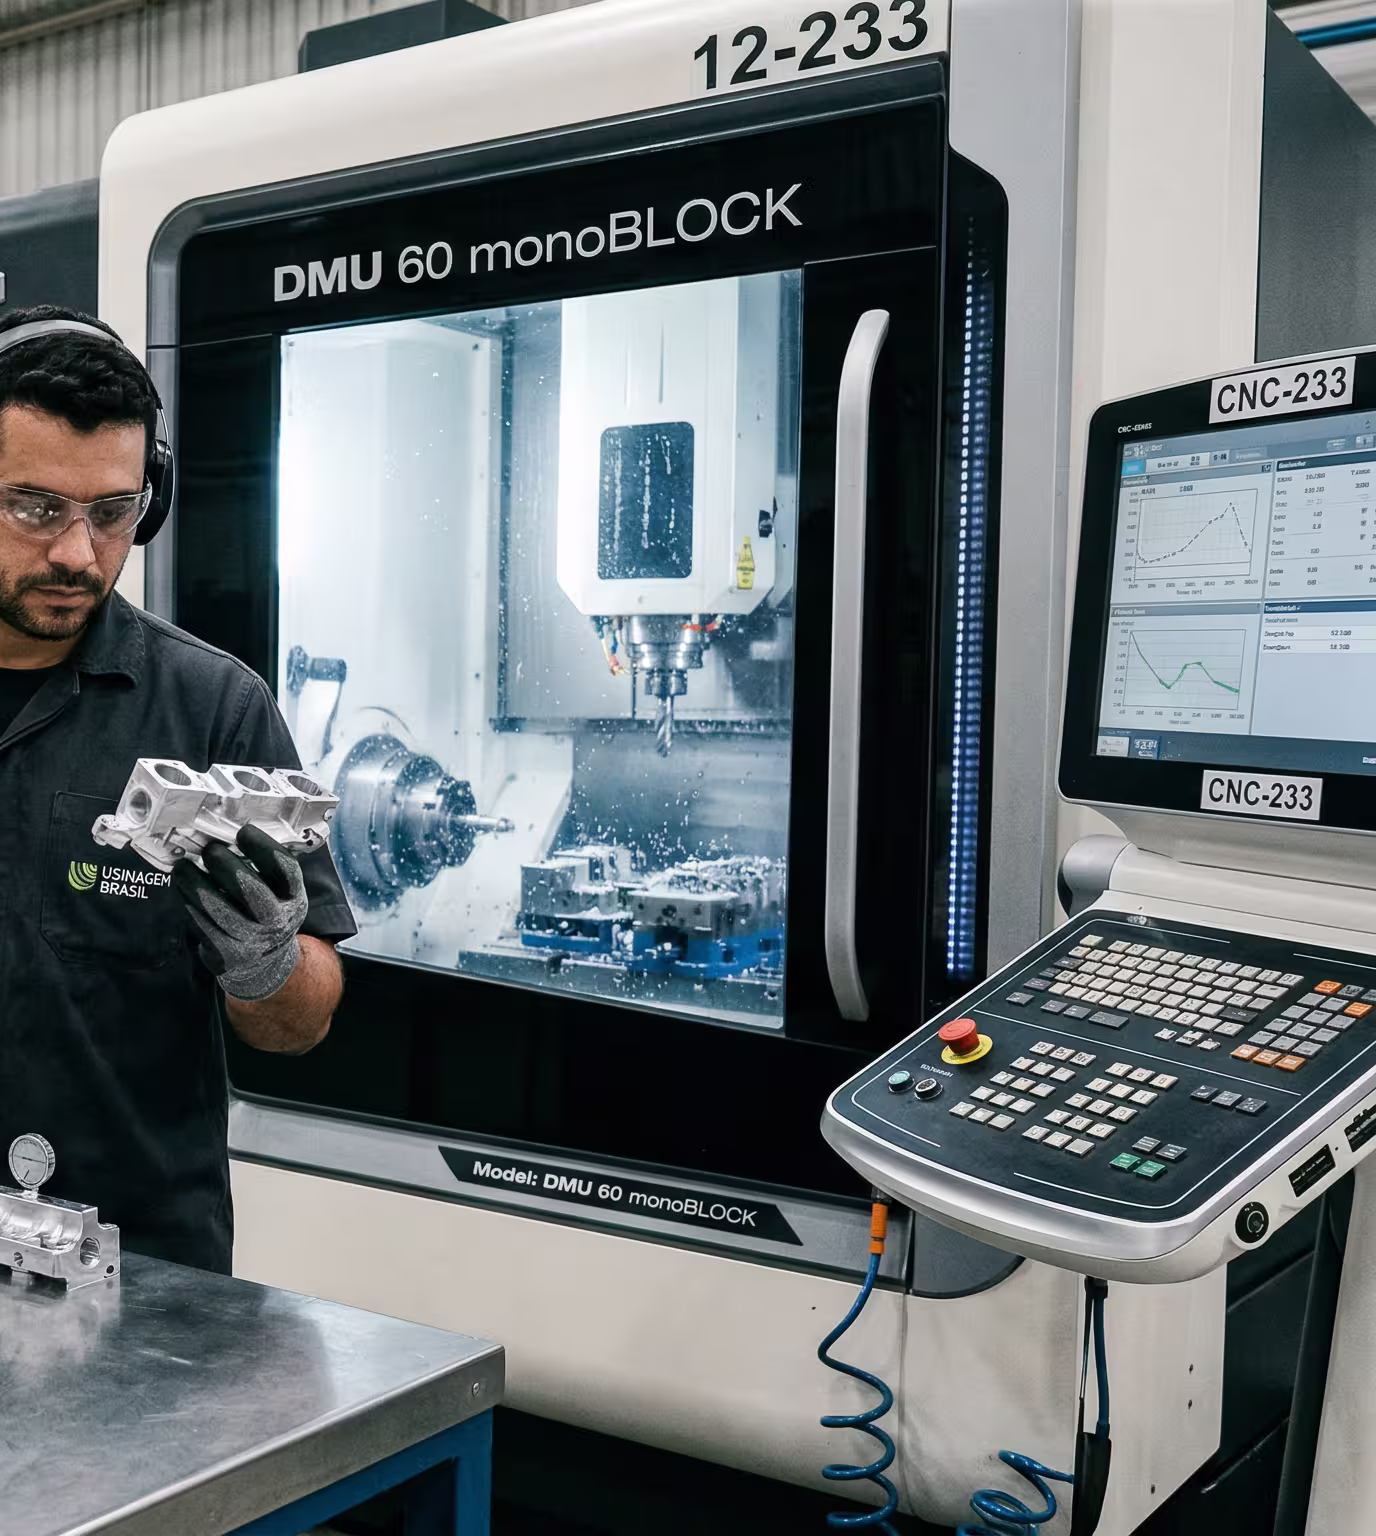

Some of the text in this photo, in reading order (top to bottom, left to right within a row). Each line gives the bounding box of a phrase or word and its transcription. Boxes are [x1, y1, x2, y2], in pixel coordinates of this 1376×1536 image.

[694, 0, 928, 90] 12-233
[273, 182, 803, 302] DMU 60 monoBLOCK
[1217, 366, 1347, 415] CNC-233
[1208, 777, 1313, 812] CNC-233
[99, 880, 149, 899] BRASIL
[101, 865, 171, 887] USINAGEM
[472, 1160, 758, 1227] Model: DMU 60 monoBLOCK
